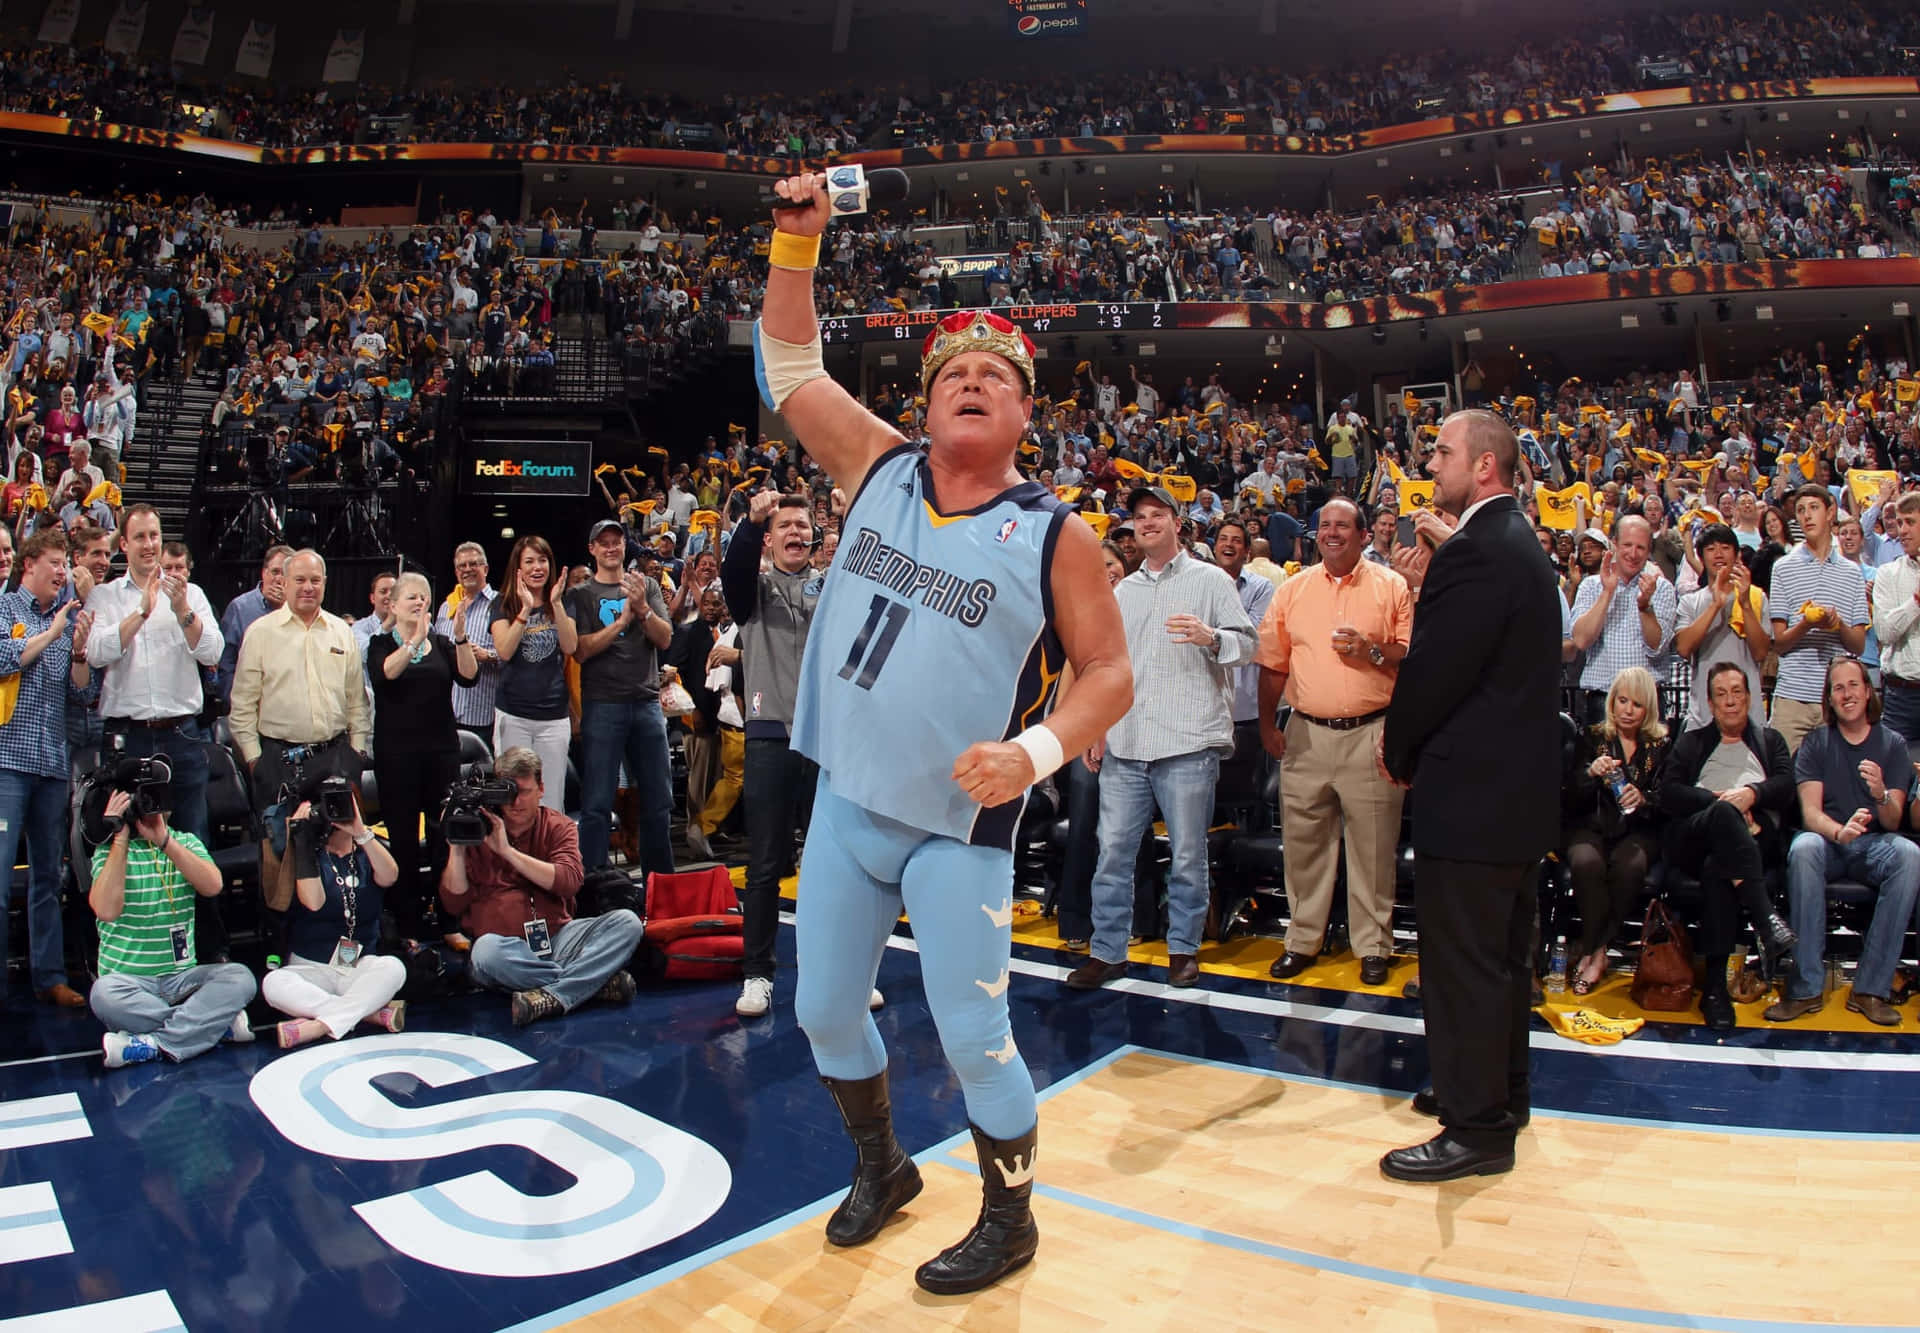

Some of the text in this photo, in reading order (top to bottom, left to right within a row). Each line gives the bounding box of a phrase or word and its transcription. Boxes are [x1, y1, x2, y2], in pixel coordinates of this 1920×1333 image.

[1042, 16, 1078, 30] pepsi
[1010, 305, 1078, 319] CLIPPERS
[1153, 303, 1160, 313] F
[865, 312, 939, 328] GRIZZLIES
[1033, 319, 1050, 331] 47
[1112, 316, 1122, 328] 3
[1152, 315, 1162, 327] 2
[823, 330, 832, 342] 4
[894, 326, 911, 338] 61
[475, 459, 574, 477] FedExForum
[842, 527, 997, 629] MEMPHIS
[838, 593, 912, 691] 11
